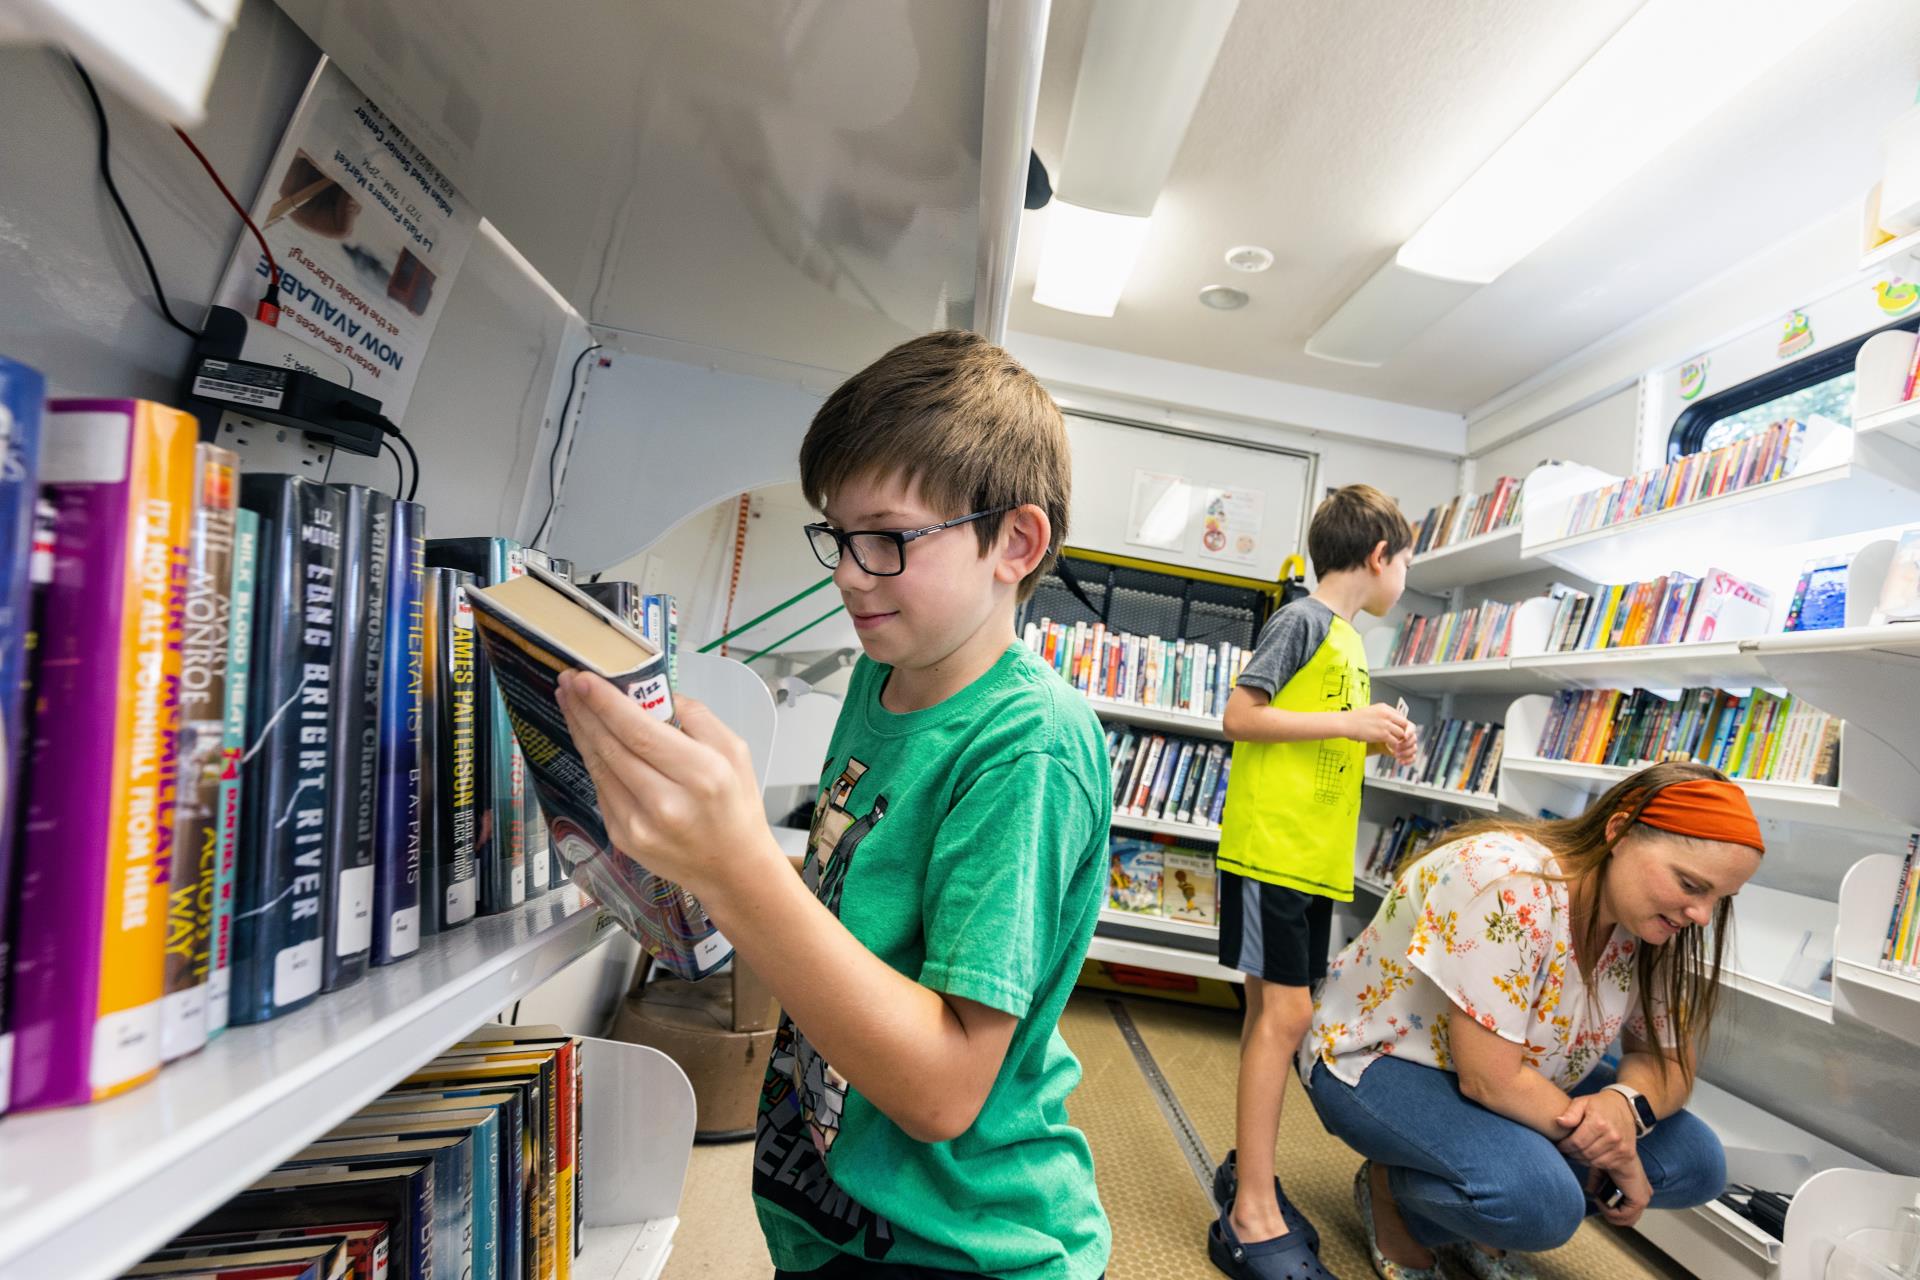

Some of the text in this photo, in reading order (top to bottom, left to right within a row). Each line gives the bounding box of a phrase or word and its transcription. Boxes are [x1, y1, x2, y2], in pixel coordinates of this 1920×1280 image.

[353, 106, 455, 218] Indian Head Senior Center
[333, 149, 434, 253] La Plata Farmers Market
[287, 246, 400, 337] at the Mobile Library!
[295, 314, 347, 355] Services
[346, 345, 382, 379] Notary
[361, 333, 404, 371] NOW
[301, 525, 340, 551] MOORE
[314, 507, 333, 527] LIZ
[369, 513, 387, 588] Walter
[143, 543, 167, 591] NOT
[139, 599, 165, 645] ALL
[180, 567, 216, 705] MONROE
[228, 532, 253, 738] MILK BLOOD HEAT
[364, 597, 384, 703] MOSLEY
[406, 600, 424, 744] THERAPIST
[131, 650, 163, 779] DOWNHILL
[290, 564, 335, 922] LONG BRIGHT RIVER
[452, 627, 475, 808] AMES PATTERSON
[358, 728, 377, 844] Charcoal
[126, 786, 155, 862] FROM
[406, 823, 421, 886] PARIS
[453, 811, 465, 844] BLACK
[121, 866, 152, 933] HERE
[452, 848, 466, 882] WIDOW
[166, 883, 199, 957] WAY
[216, 914, 231, 969] MONI
